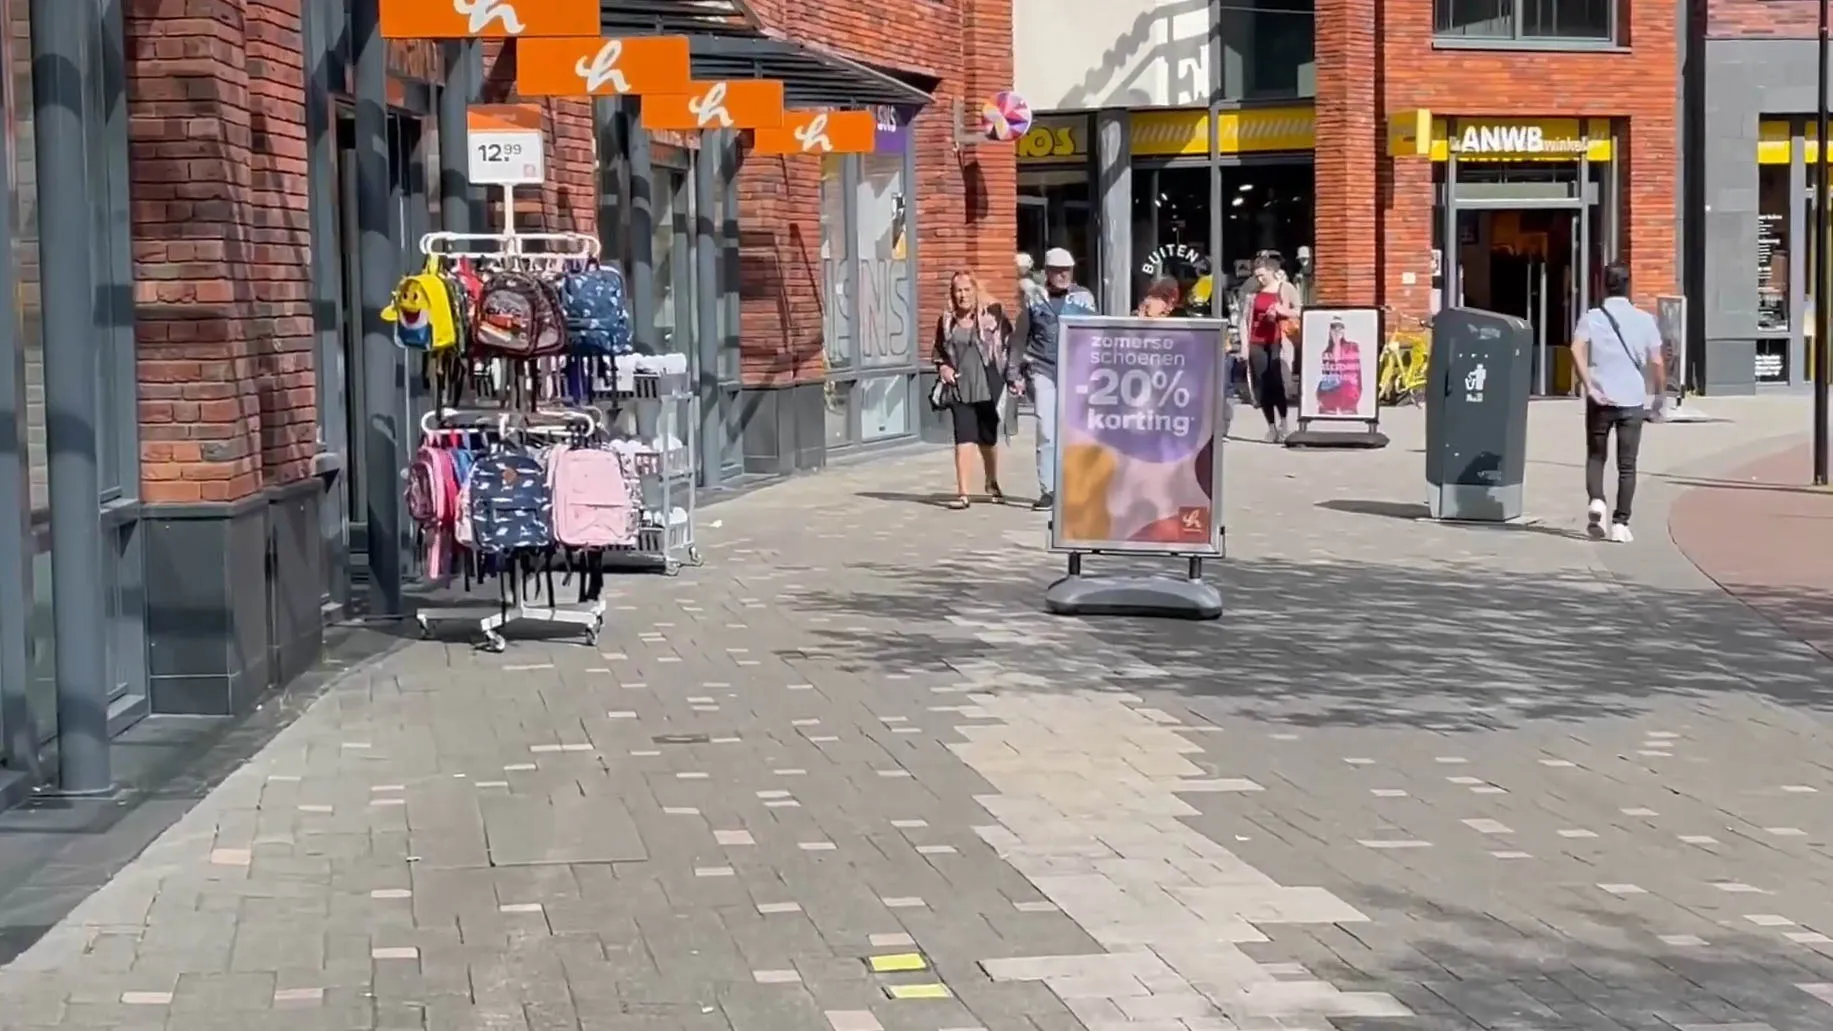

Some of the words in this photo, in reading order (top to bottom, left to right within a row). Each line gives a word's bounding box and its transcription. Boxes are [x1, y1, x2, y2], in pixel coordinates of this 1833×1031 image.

[1462, 125, 1544, 152] ANWB
[1142, 244, 1199, 274] BUITEN
[1091, 335, 1174, 350] zomerse
[1090, 350, 1185, 366] schoenen
[1075, 368, 1190, 408] -20%
